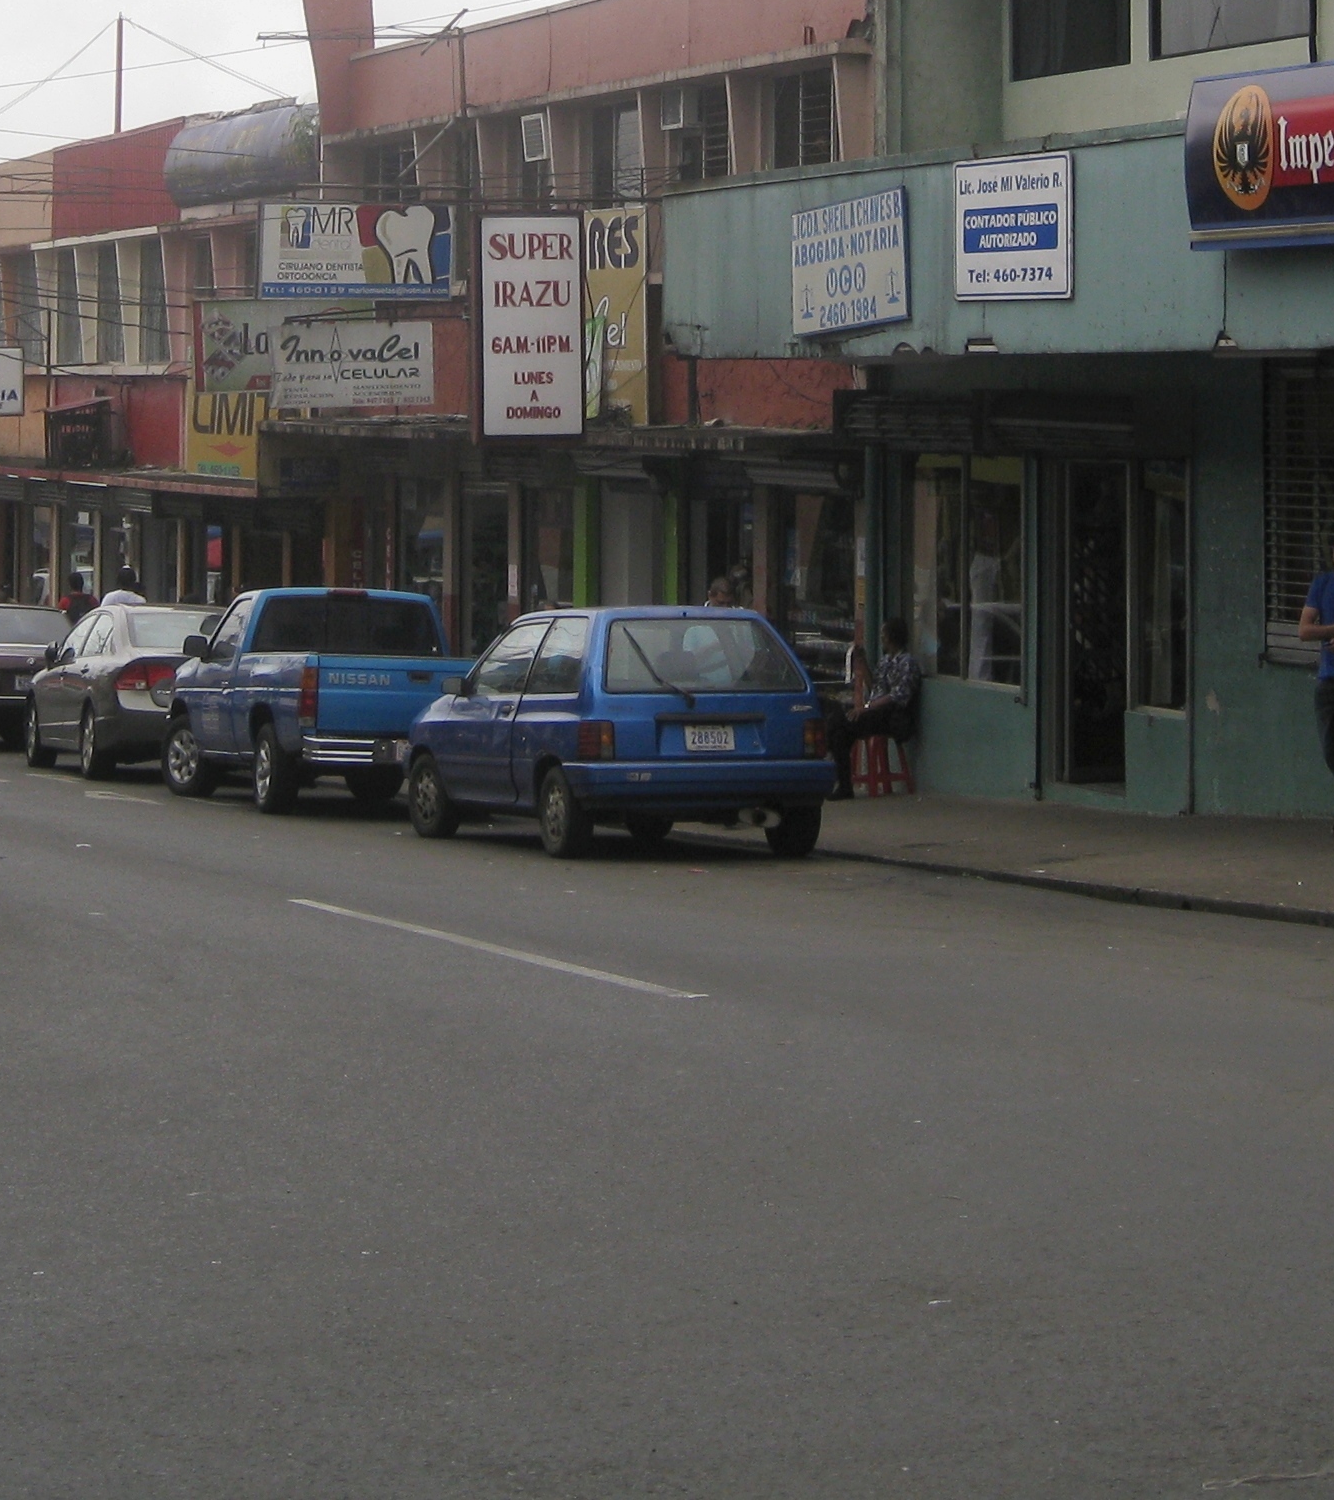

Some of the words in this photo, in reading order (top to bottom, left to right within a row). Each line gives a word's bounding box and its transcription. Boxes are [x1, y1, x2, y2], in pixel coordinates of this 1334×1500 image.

[959, 179, 975, 196] Lic.
[976, 176, 998, 194] José
[1015, 173, 1050, 191] Valerio
[1052, 171, 1063, 188] R.
[312, 206, 354, 235] MR
[965, 213, 1016, 230] CONTADOR
[1017, 209, 1057, 227] PÚBLICO
[487, 233, 574, 261] SUPER
[979, 231, 1038, 249] AUTORIZADO
[278, 262, 323, 271] CIRUJANO
[325, 261, 365, 271] DENTISTA
[968, 268, 990, 284] Tel:
[993, 266, 1053, 283] 460-7374
[277, 272, 338, 281] ORTODONCIA
[493, 280, 571, 308] IRAZU
[280, 334, 420, 364] InnovaCel
[340, 367, 420, 381] CELULAR
[514, 371, 554, 385] LUNES
[530, 390, 539, 402] A
[506, 406, 561, 420] DOMINGO
[328, 672, 391, 686] NISSAN
